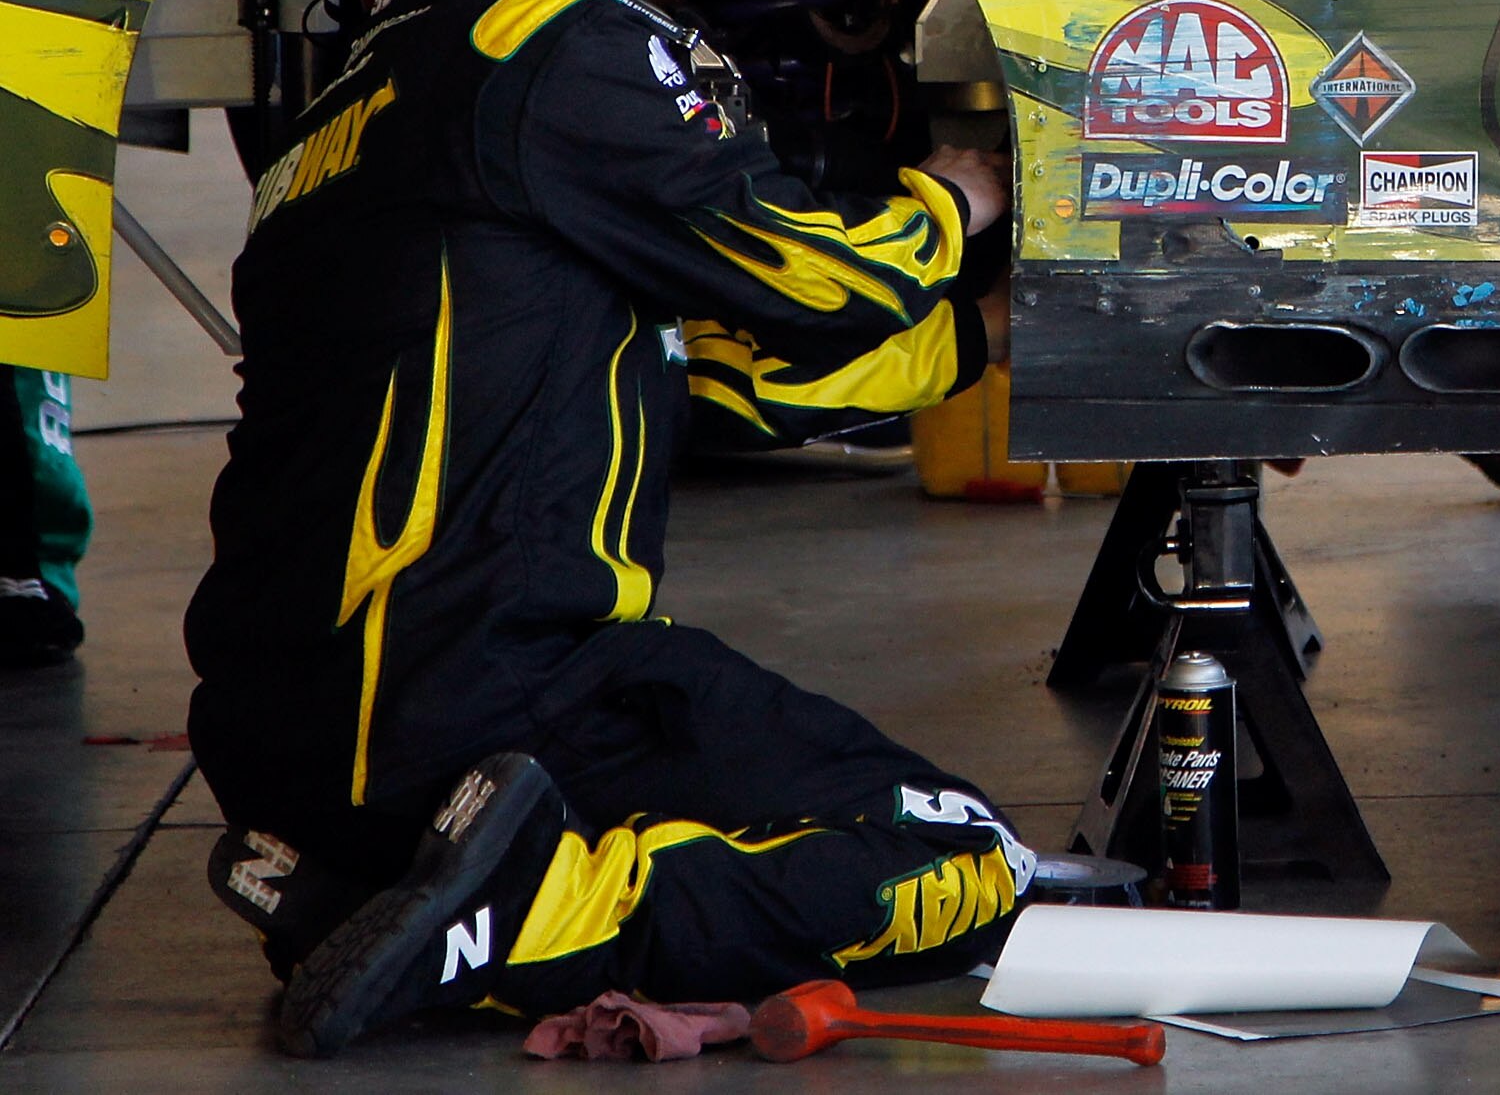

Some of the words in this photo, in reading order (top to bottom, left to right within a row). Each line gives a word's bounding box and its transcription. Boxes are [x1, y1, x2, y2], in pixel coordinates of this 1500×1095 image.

[1101, 11, 1274, 99] MAC
[1321, 78, 1403, 94] INTERNATIONAL
[1107, 99, 1272, 128] TOOLS
[1370, 170, 1468, 193] CHAMPION
[1421, 209, 1471, 224] PLUGS
[1181, 748, 1222, 768] Parts
[1160, 768, 1215, 789] EANER
